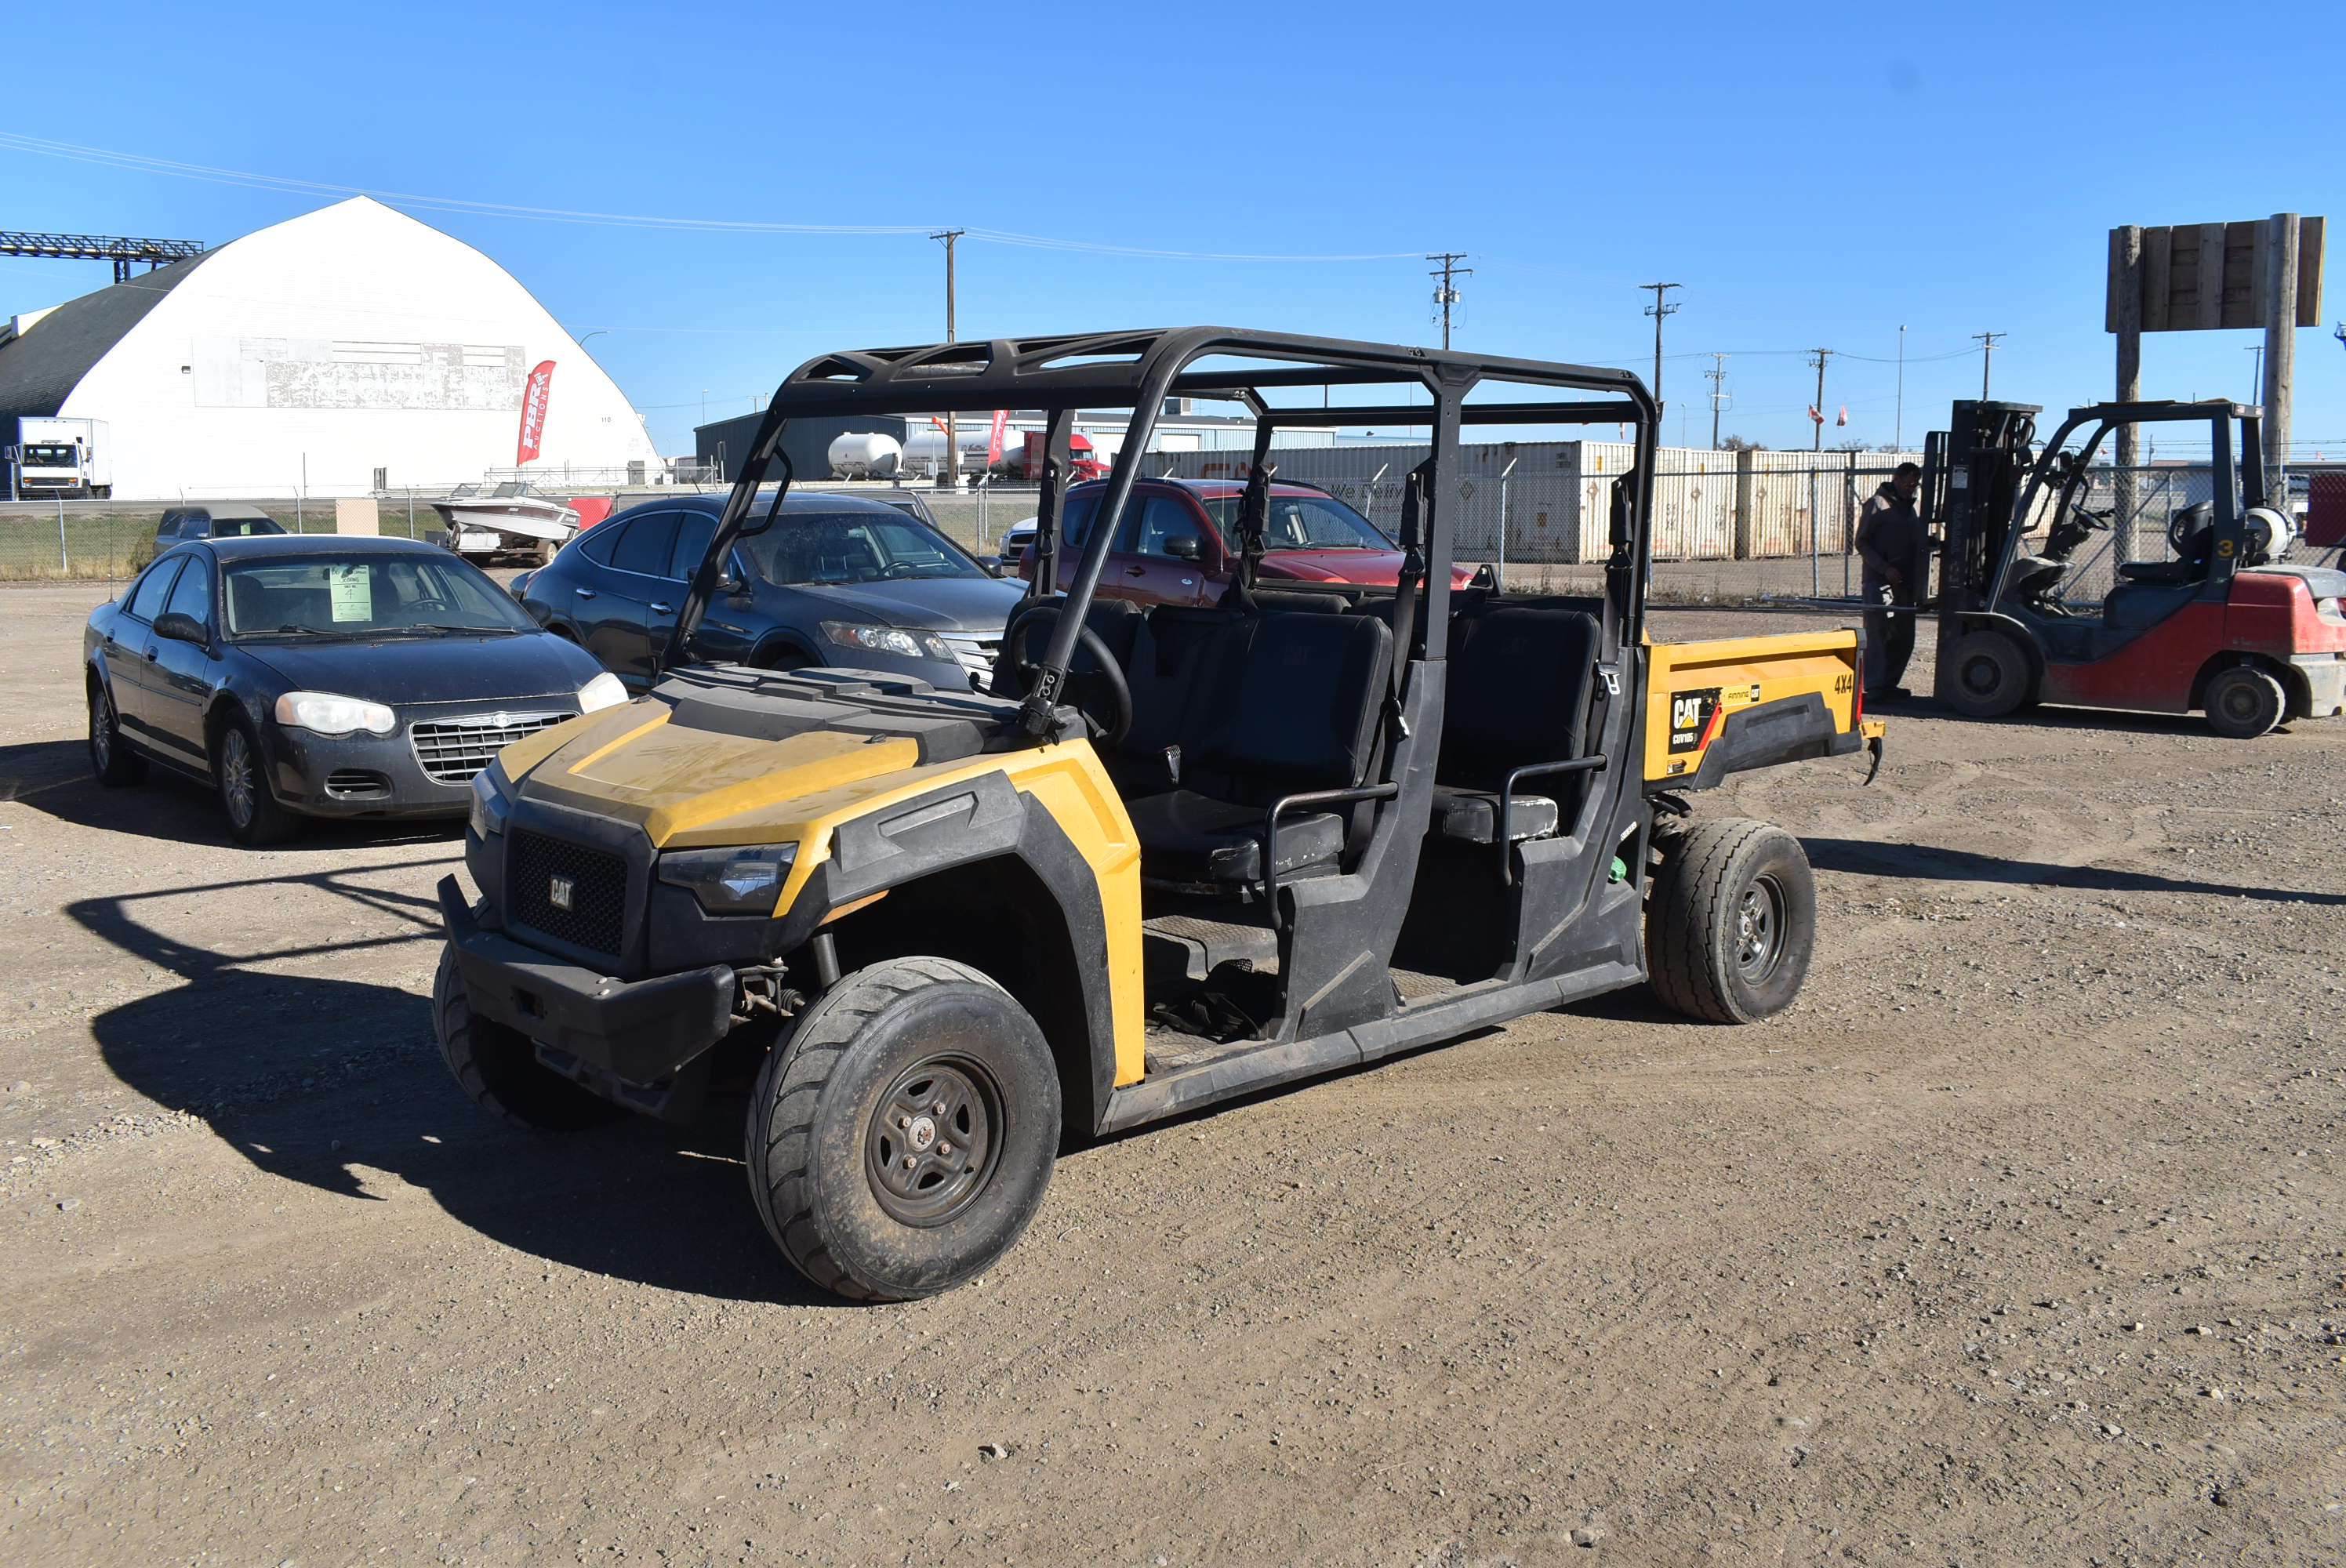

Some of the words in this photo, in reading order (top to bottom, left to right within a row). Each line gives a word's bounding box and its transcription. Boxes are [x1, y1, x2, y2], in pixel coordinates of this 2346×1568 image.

[523, 383, 541, 448] PBR
[533, 387, 549, 450] AUCTIONS
[2218, 539, 2233, 557] 3
[1835, 674, 1852, 694] 4X4
[1674, 698, 1701, 729] CAT
[552, 879, 571, 906] CAT
